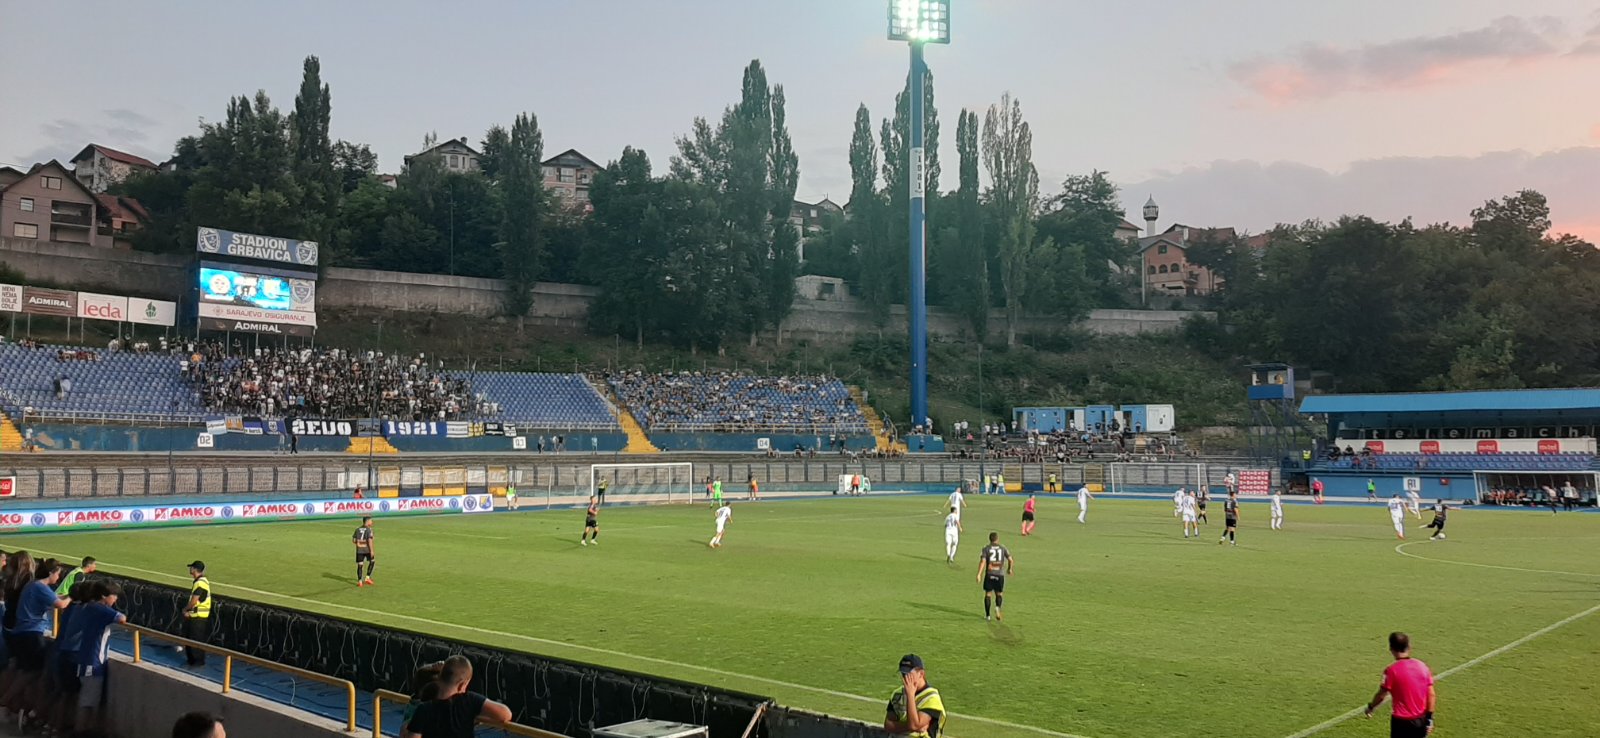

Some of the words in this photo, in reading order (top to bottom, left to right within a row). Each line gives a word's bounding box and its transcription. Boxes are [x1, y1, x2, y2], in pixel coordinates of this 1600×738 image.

[231, 233, 287, 251] STADION
[227, 243, 291, 262] GRBAVICA
[29, 296, 72, 308] ADMIRAL
[83, 300, 122, 319] leda
[226, 309, 262, 318] SARAJEVO
[264, 311, 306, 321] OSIGURANJE
[234, 321, 282, 333] ADMIRAL
[387, 420, 438, 436] 1921
[199, 435, 211, 445] 02
[1407, 478, 1417, 489] A1
[257, 503, 298, 514] AMKO
[337, 501, 374, 511] AMKO
[410, 498, 444, 509] AMKO
[75, 510, 123, 521] AMKO
[170, 506, 214, 518] AMKO
[989, 549, 1002, 562] 21
